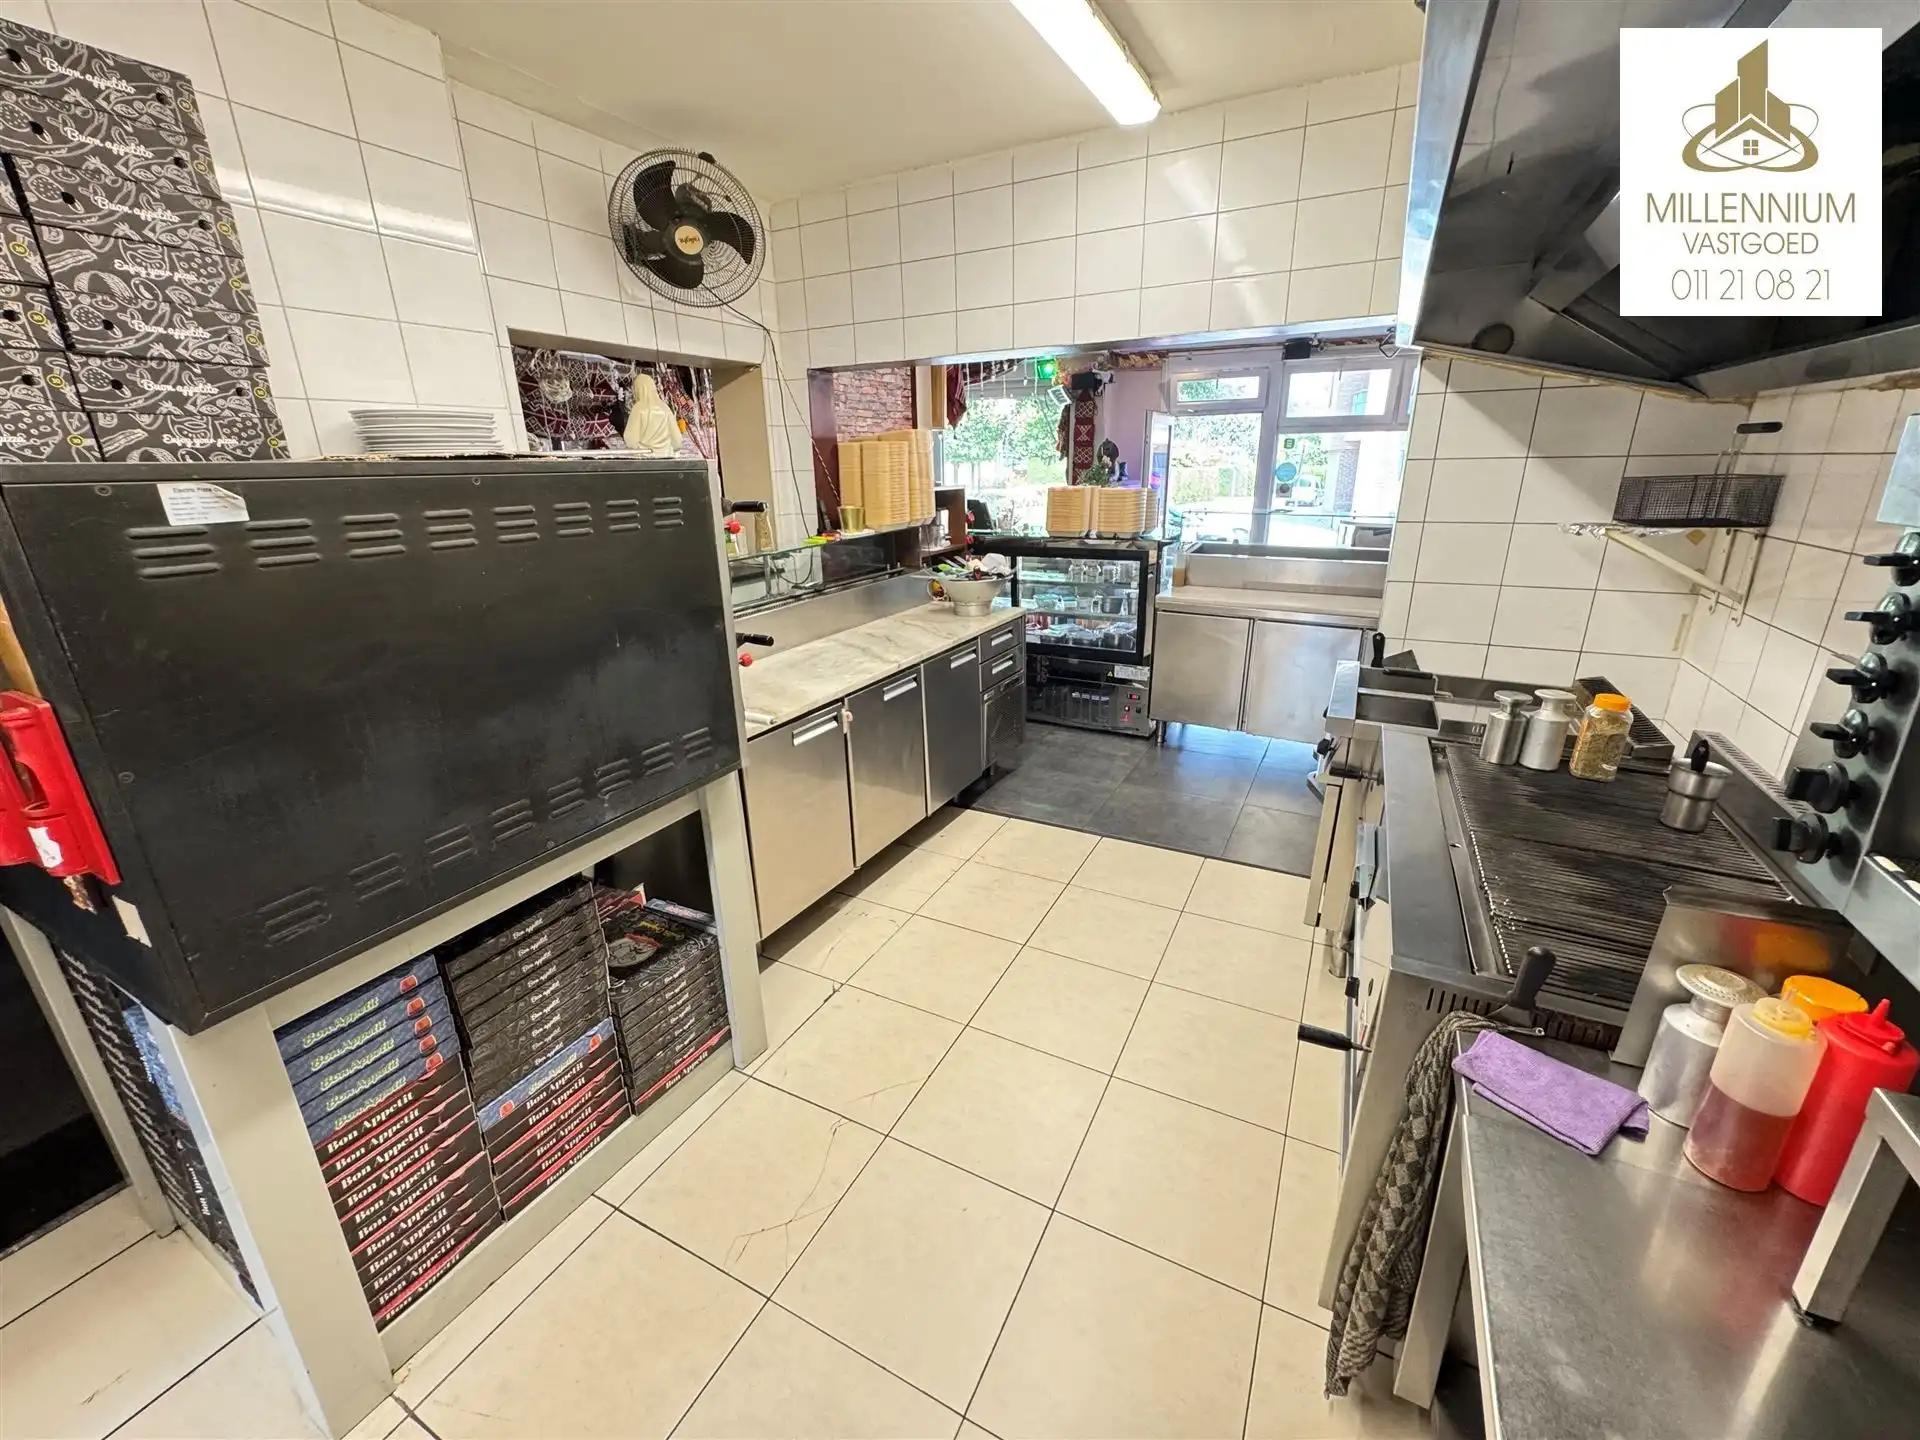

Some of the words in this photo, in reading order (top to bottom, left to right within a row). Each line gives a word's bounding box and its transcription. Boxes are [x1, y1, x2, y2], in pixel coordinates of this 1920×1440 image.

[43, 57, 84, 80] Buon
[64, 126, 104, 148] Buon
[95, 196, 133, 214] Buon
[132, 320, 167, 334] Buon
[141, 379, 176, 392] Buon
[303, 1028, 334, 1048] Bon
[334, 997, 379, 1029] Appetit
[311, 1051, 341, 1071] Bon
[341, 1019, 387, 1053] Appetit
[321, 1069, 350, 1091] Bon
[350, 1039, 395, 1071] Appetit
[327, 1090, 356, 1111] Bon
[356, 1058, 399, 1092] Appetit
[526, 1091, 547, 1110] Bon
[549, 1062, 584, 1093] Appetit
[666, 1074, 681, 1089] Bon
[682, 1051, 708, 1074] Appetit
[327, 1130, 358, 1153] Bon
[362, 1092, 414, 1132] Appetit
[528, 1106, 549, 1125] Bon
[551, 1076, 586, 1109] Appetit
[536, 1122, 556, 1139] Bon
[559, 1091, 592, 1123] Appetit
[335, 1146, 365, 1171] Bon
[369, 1108, 420, 1149] Appetit
[536, 1137, 556, 1156] Bon
[558, 1107, 592, 1139] Appetit
[542, 1151, 561, 1170] Bon
[564, 1121, 597, 1153] Appetit
[341, 1165, 371, 1189] Bon
[374, 1126, 425, 1167] Appetit
[347, 1182, 376, 1207] Bon
[380, 1142, 430, 1184] Appetit
[547, 1167, 565, 1185] Bon
[568, 1136, 600, 1167] Appetit
[354, 1200, 384, 1223] Bon
[388, 1159, 436, 1200] Appetit
[358, 1215, 387, 1239] Bon
[390, 1174, 439, 1216] Appetit
[366, 1232, 395, 1256] Bon
[397, 1191, 446, 1234] Appetit
[369, 1249, 398, 1274] Bon
[400, 1207, 448, 1251] Appetit
[373, 1265, 402, 1290] Bon
[404, 1223, 451, 1266] Appetit
[379, 1280, 406, 1305] Bon
[409, 1238, 456, 1281] Appetit
